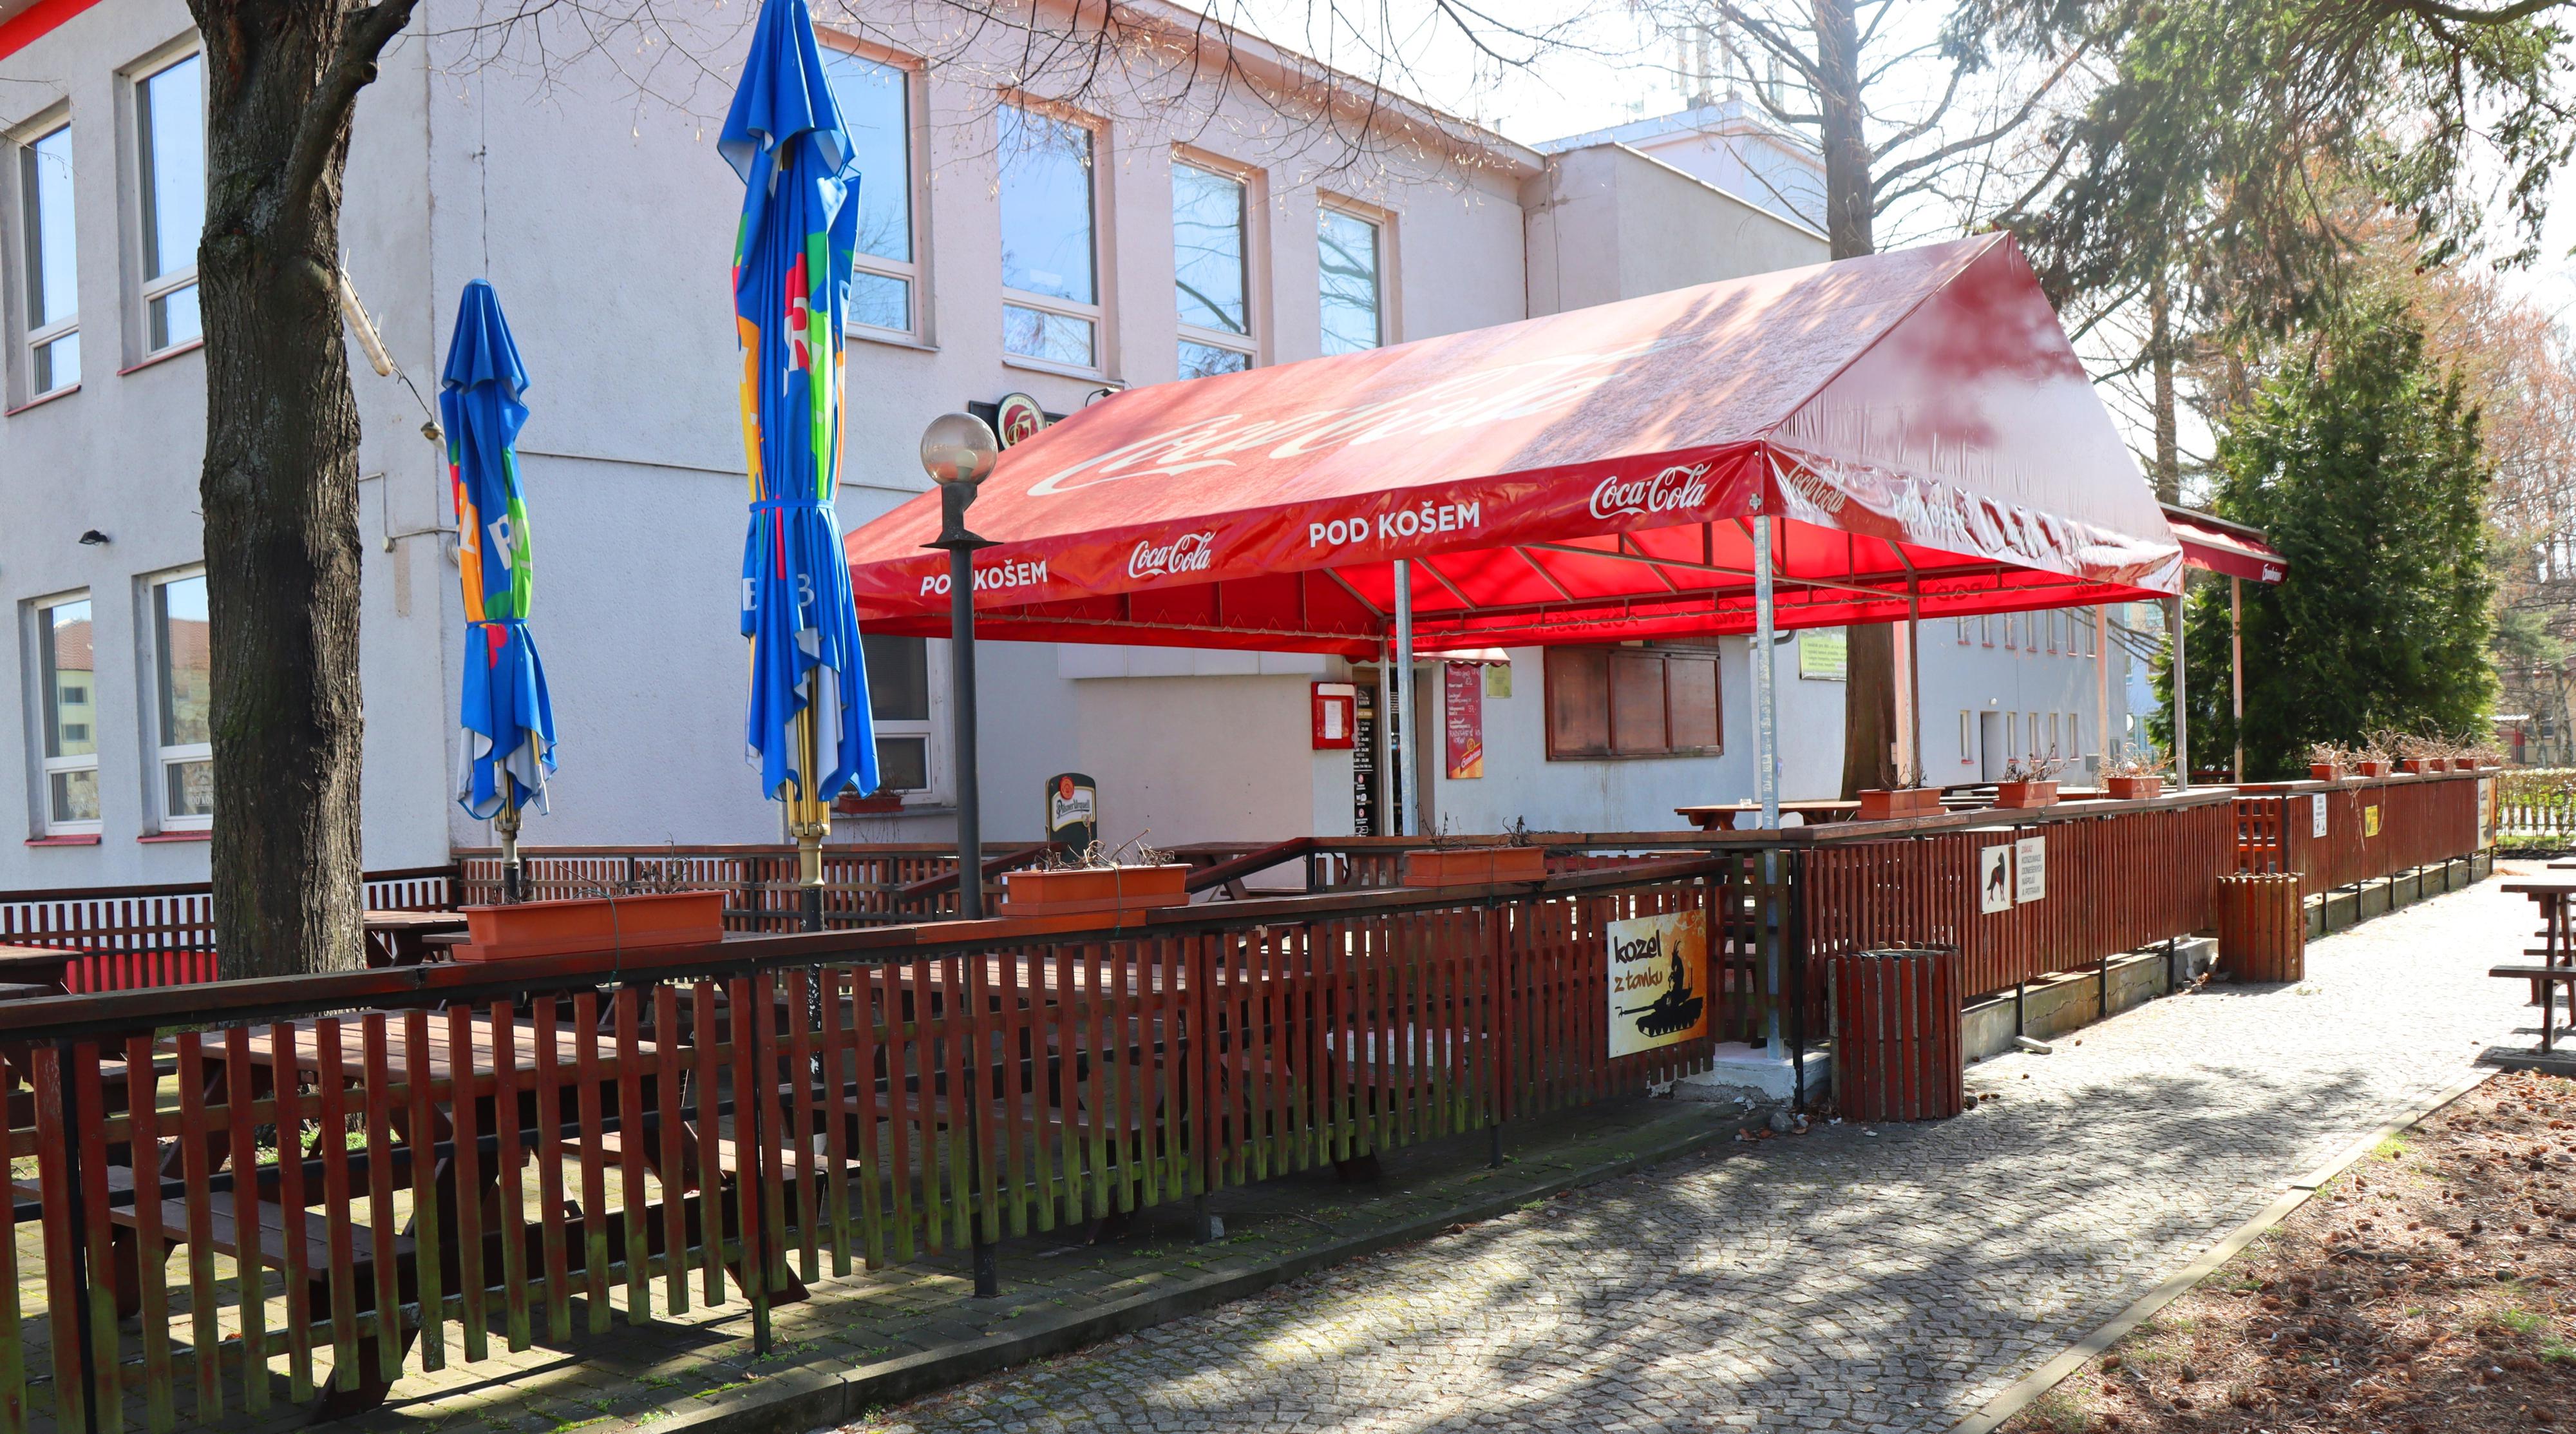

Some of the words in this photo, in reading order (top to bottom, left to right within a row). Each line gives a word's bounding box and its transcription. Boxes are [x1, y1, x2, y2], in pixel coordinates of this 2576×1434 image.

[1589, 463, 1712, 519] Coca-Cola
[1788, 464, 1846, 513] Coca-Cola
[1310, 517, 1369, 548] POD
[1379, 501, 1480, 539] KOŠEM
[1128, 531, 1217, 578] Coca-Cola
[920, 575, 952, 597] PO
[973, 559, 1048, 591] KOŠEM
[1057, 799, 1074, 819] Pilsner
[1074, 799, 1090, 810] Urquell
[2021, 844, 2033, 854] ZÁKAZ
[2022, 854, 2041, 864] KONZUMACE
[1614, 929, 1662, 964] kozel
[1614, 976, 1625, 993] z
[1625, 966, 1663, 990] tanku
